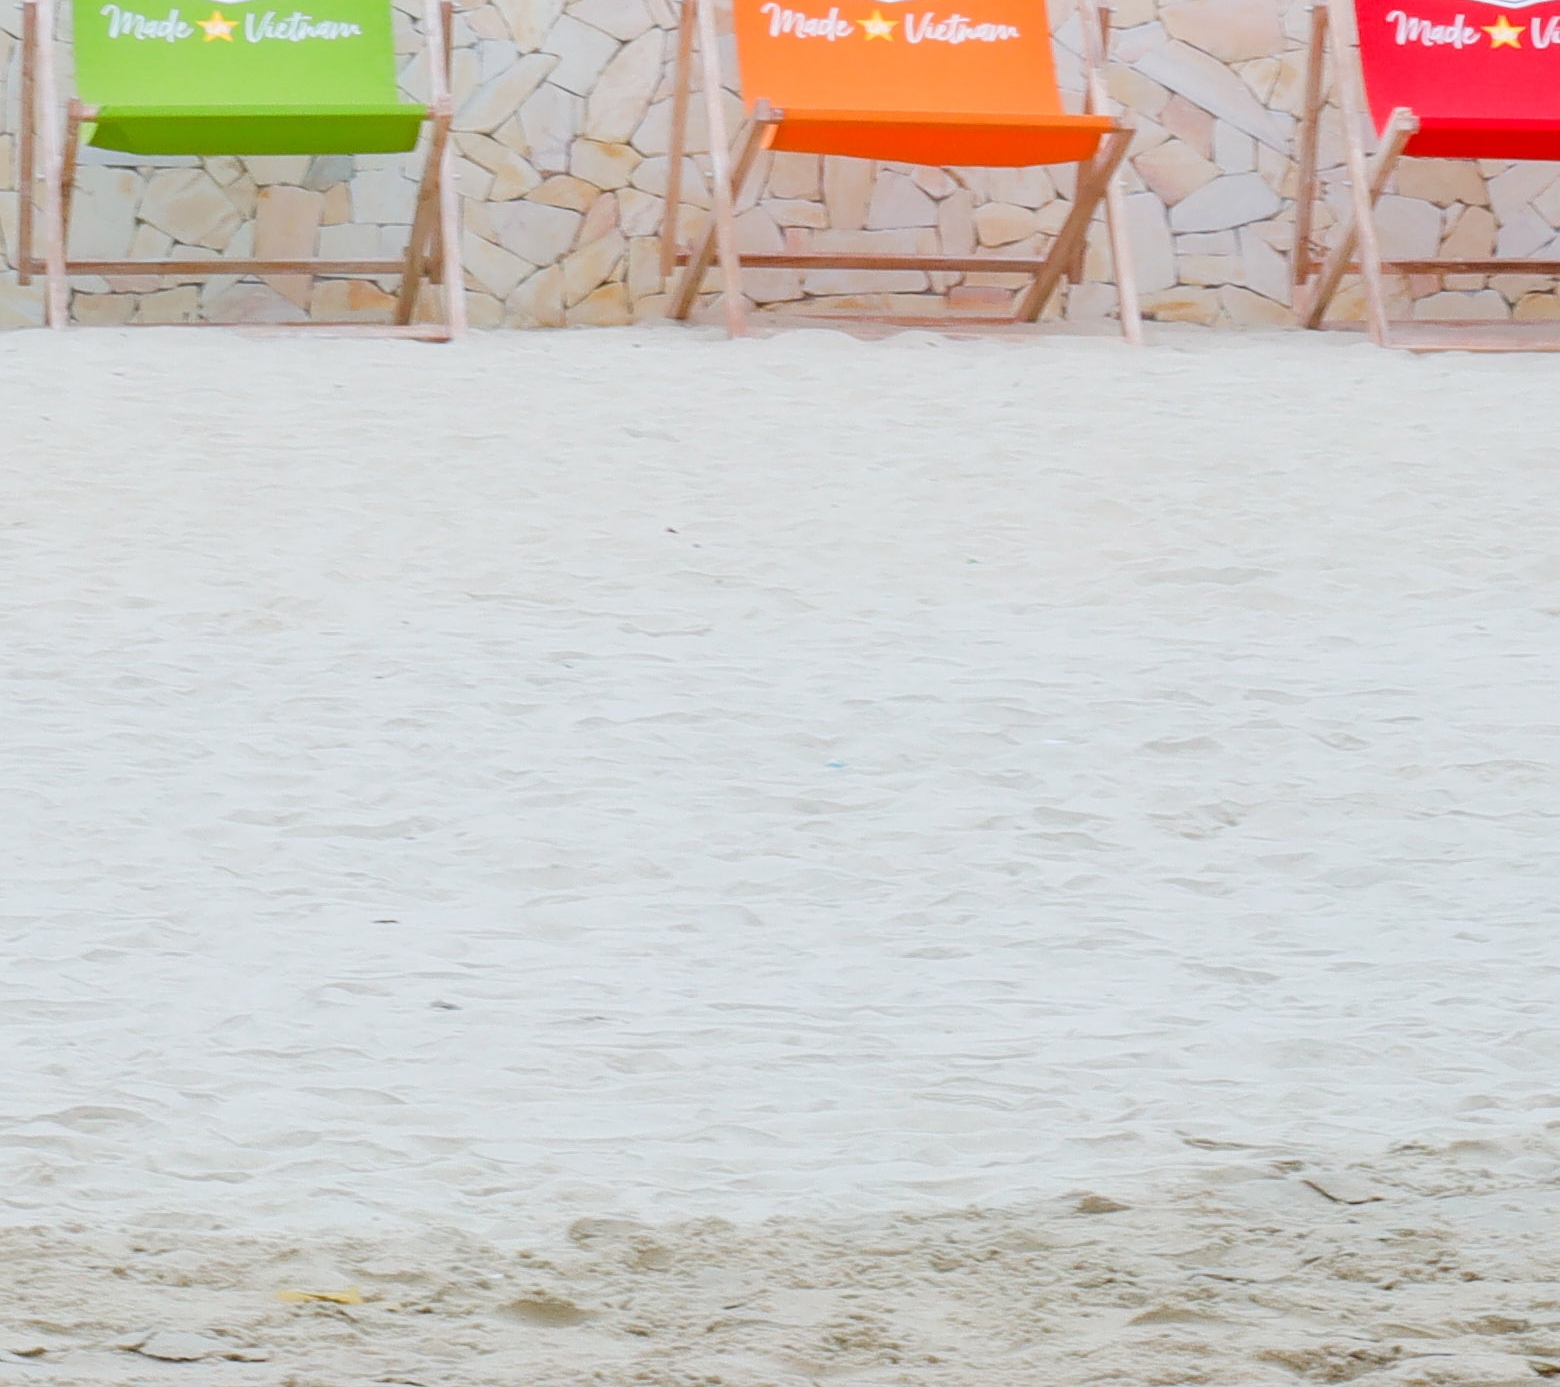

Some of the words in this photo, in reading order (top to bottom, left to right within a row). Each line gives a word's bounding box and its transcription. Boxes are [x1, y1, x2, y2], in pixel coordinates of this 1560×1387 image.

[100, 3, 195, 43] Made
[243, 10, 363, 44] Vietnam
[761, 2, 854, 41] Made
[904, 12, 1020, 44] Vietnam
[1386, 11, 1480, 49] Made
